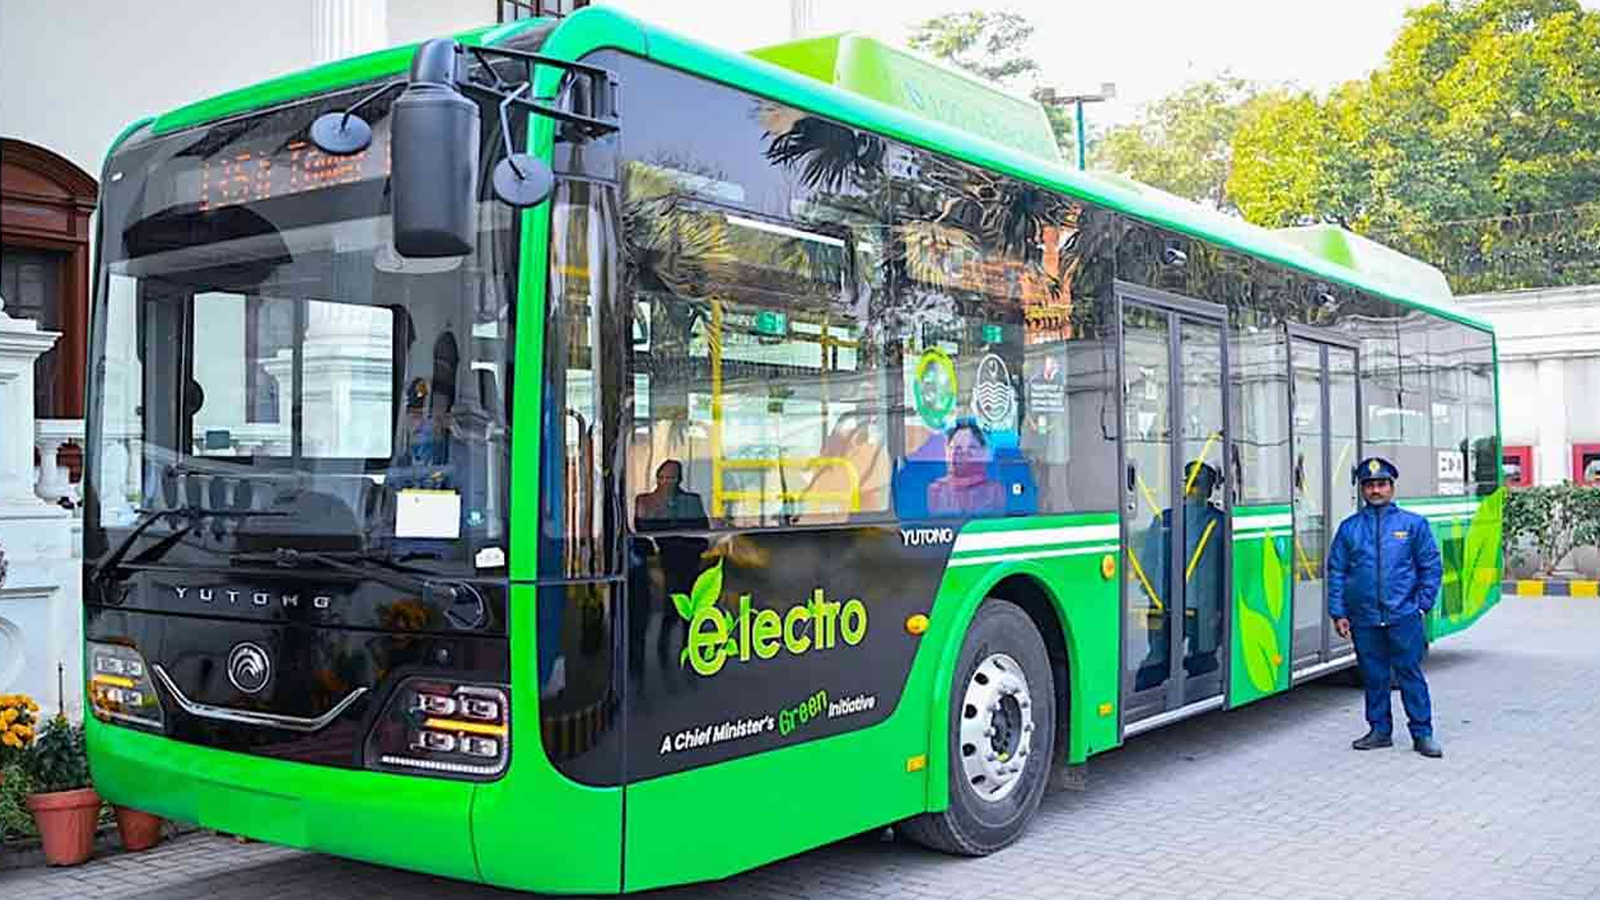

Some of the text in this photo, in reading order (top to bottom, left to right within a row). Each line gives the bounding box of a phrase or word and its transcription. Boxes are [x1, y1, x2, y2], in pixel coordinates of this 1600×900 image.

[901, 527, 953, 546] YUTONG
[688, 588, 867, 676] electro
[660, 689, 875, 754] A Chief Minister's Green Initiative
